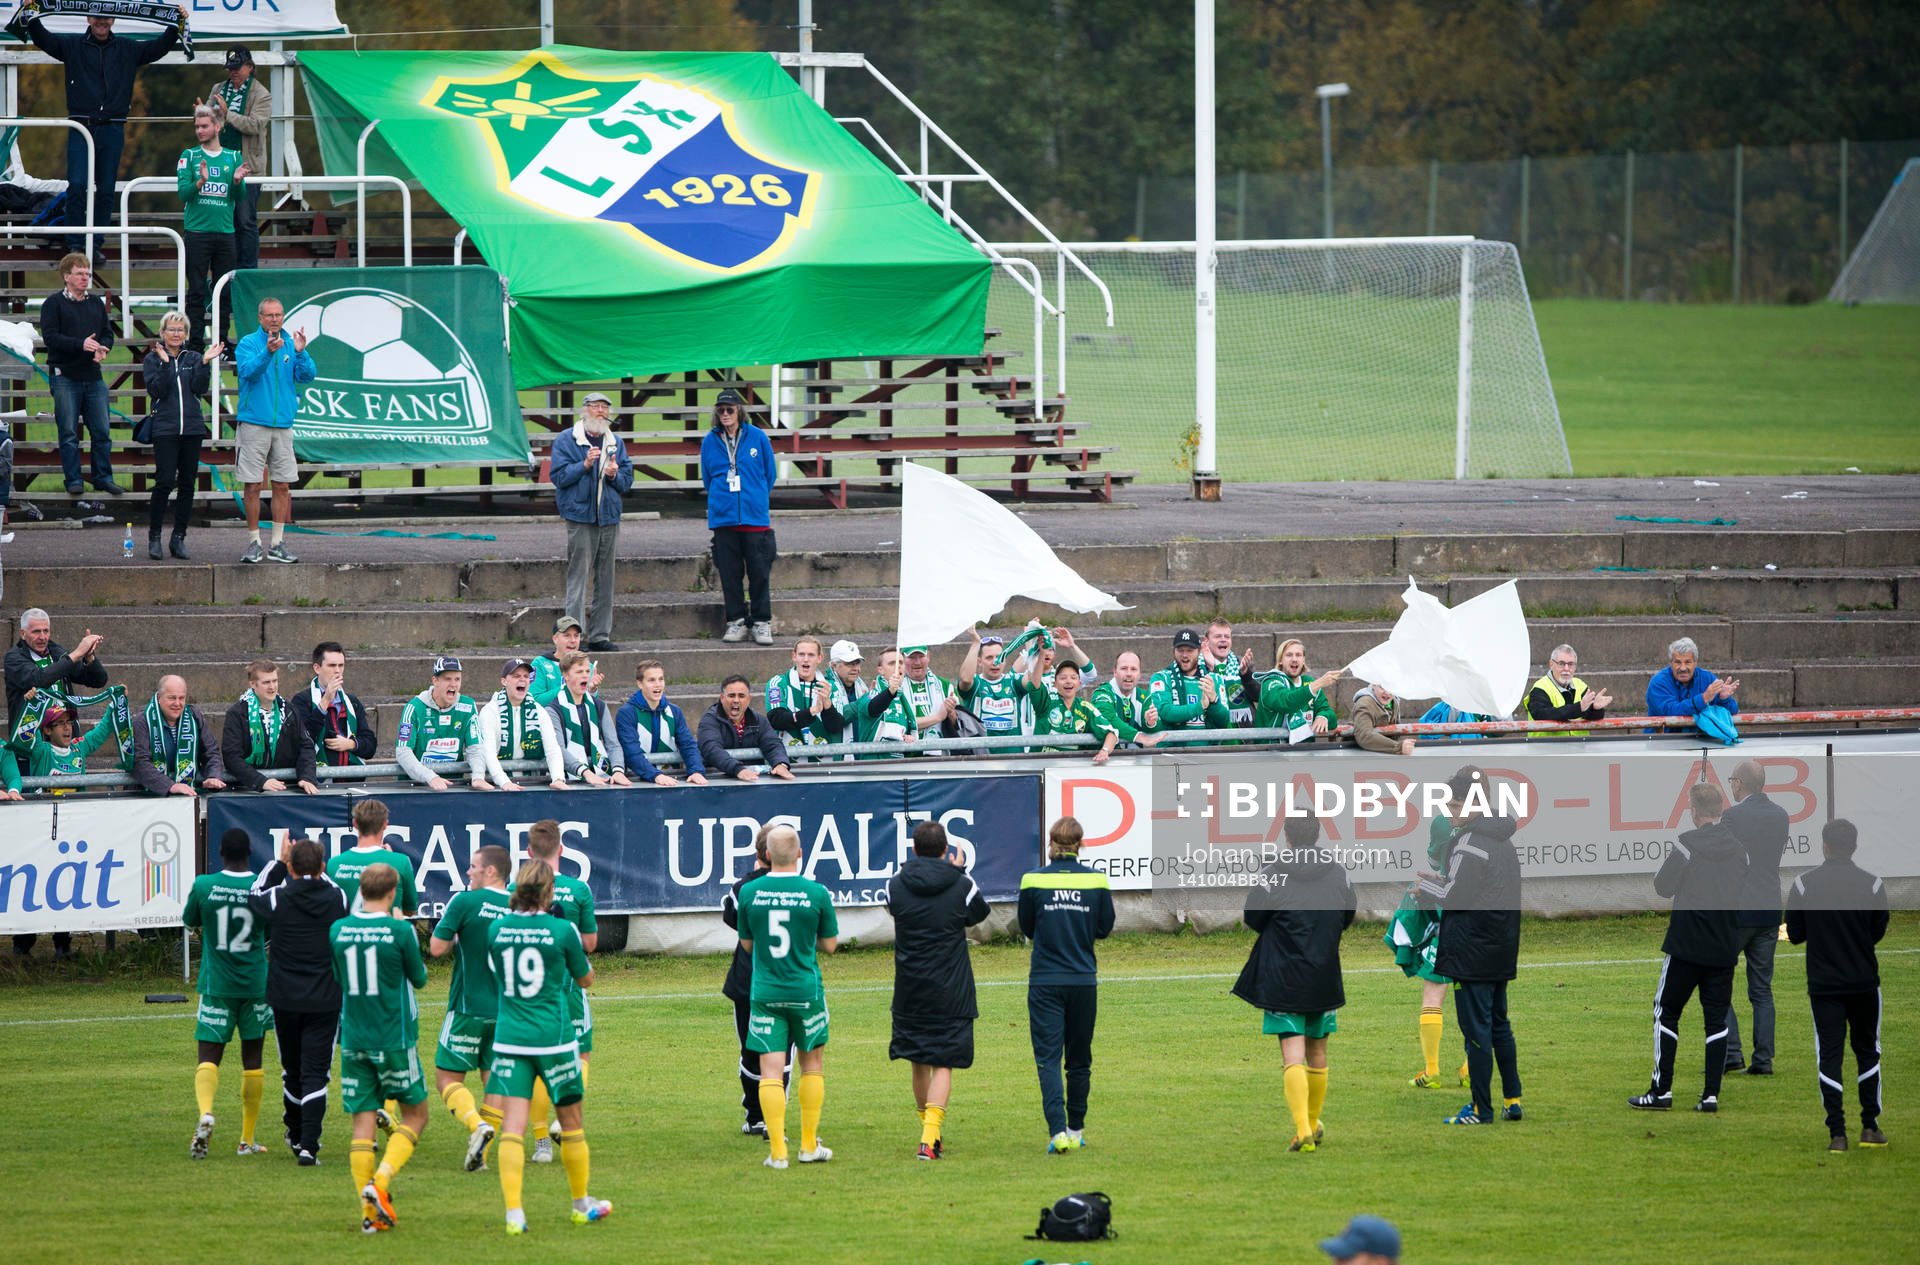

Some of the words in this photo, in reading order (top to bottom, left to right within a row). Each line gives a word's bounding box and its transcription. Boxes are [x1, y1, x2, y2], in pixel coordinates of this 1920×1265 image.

[203, 182, 227, 194] BDO
[643, 173, 793, 209] 1926
[361, 391, 462, 421] FANS
[293, 429, 363, 440] UNGSKILE
[152, 832, 171, 853] R
[1515, 843, 1598, 865] ERFORS
[1080, 856, 1195, 878] EGERFORS
[1052, 889, 1081, 902] JWG
[134, 915, 183, 926] BREDBAN
[215, 905, 254, 953] 12
[768, 909, 791, 959] 5
[344, 944, 379, 996] 11
[501, 946, 545, 999] 19
